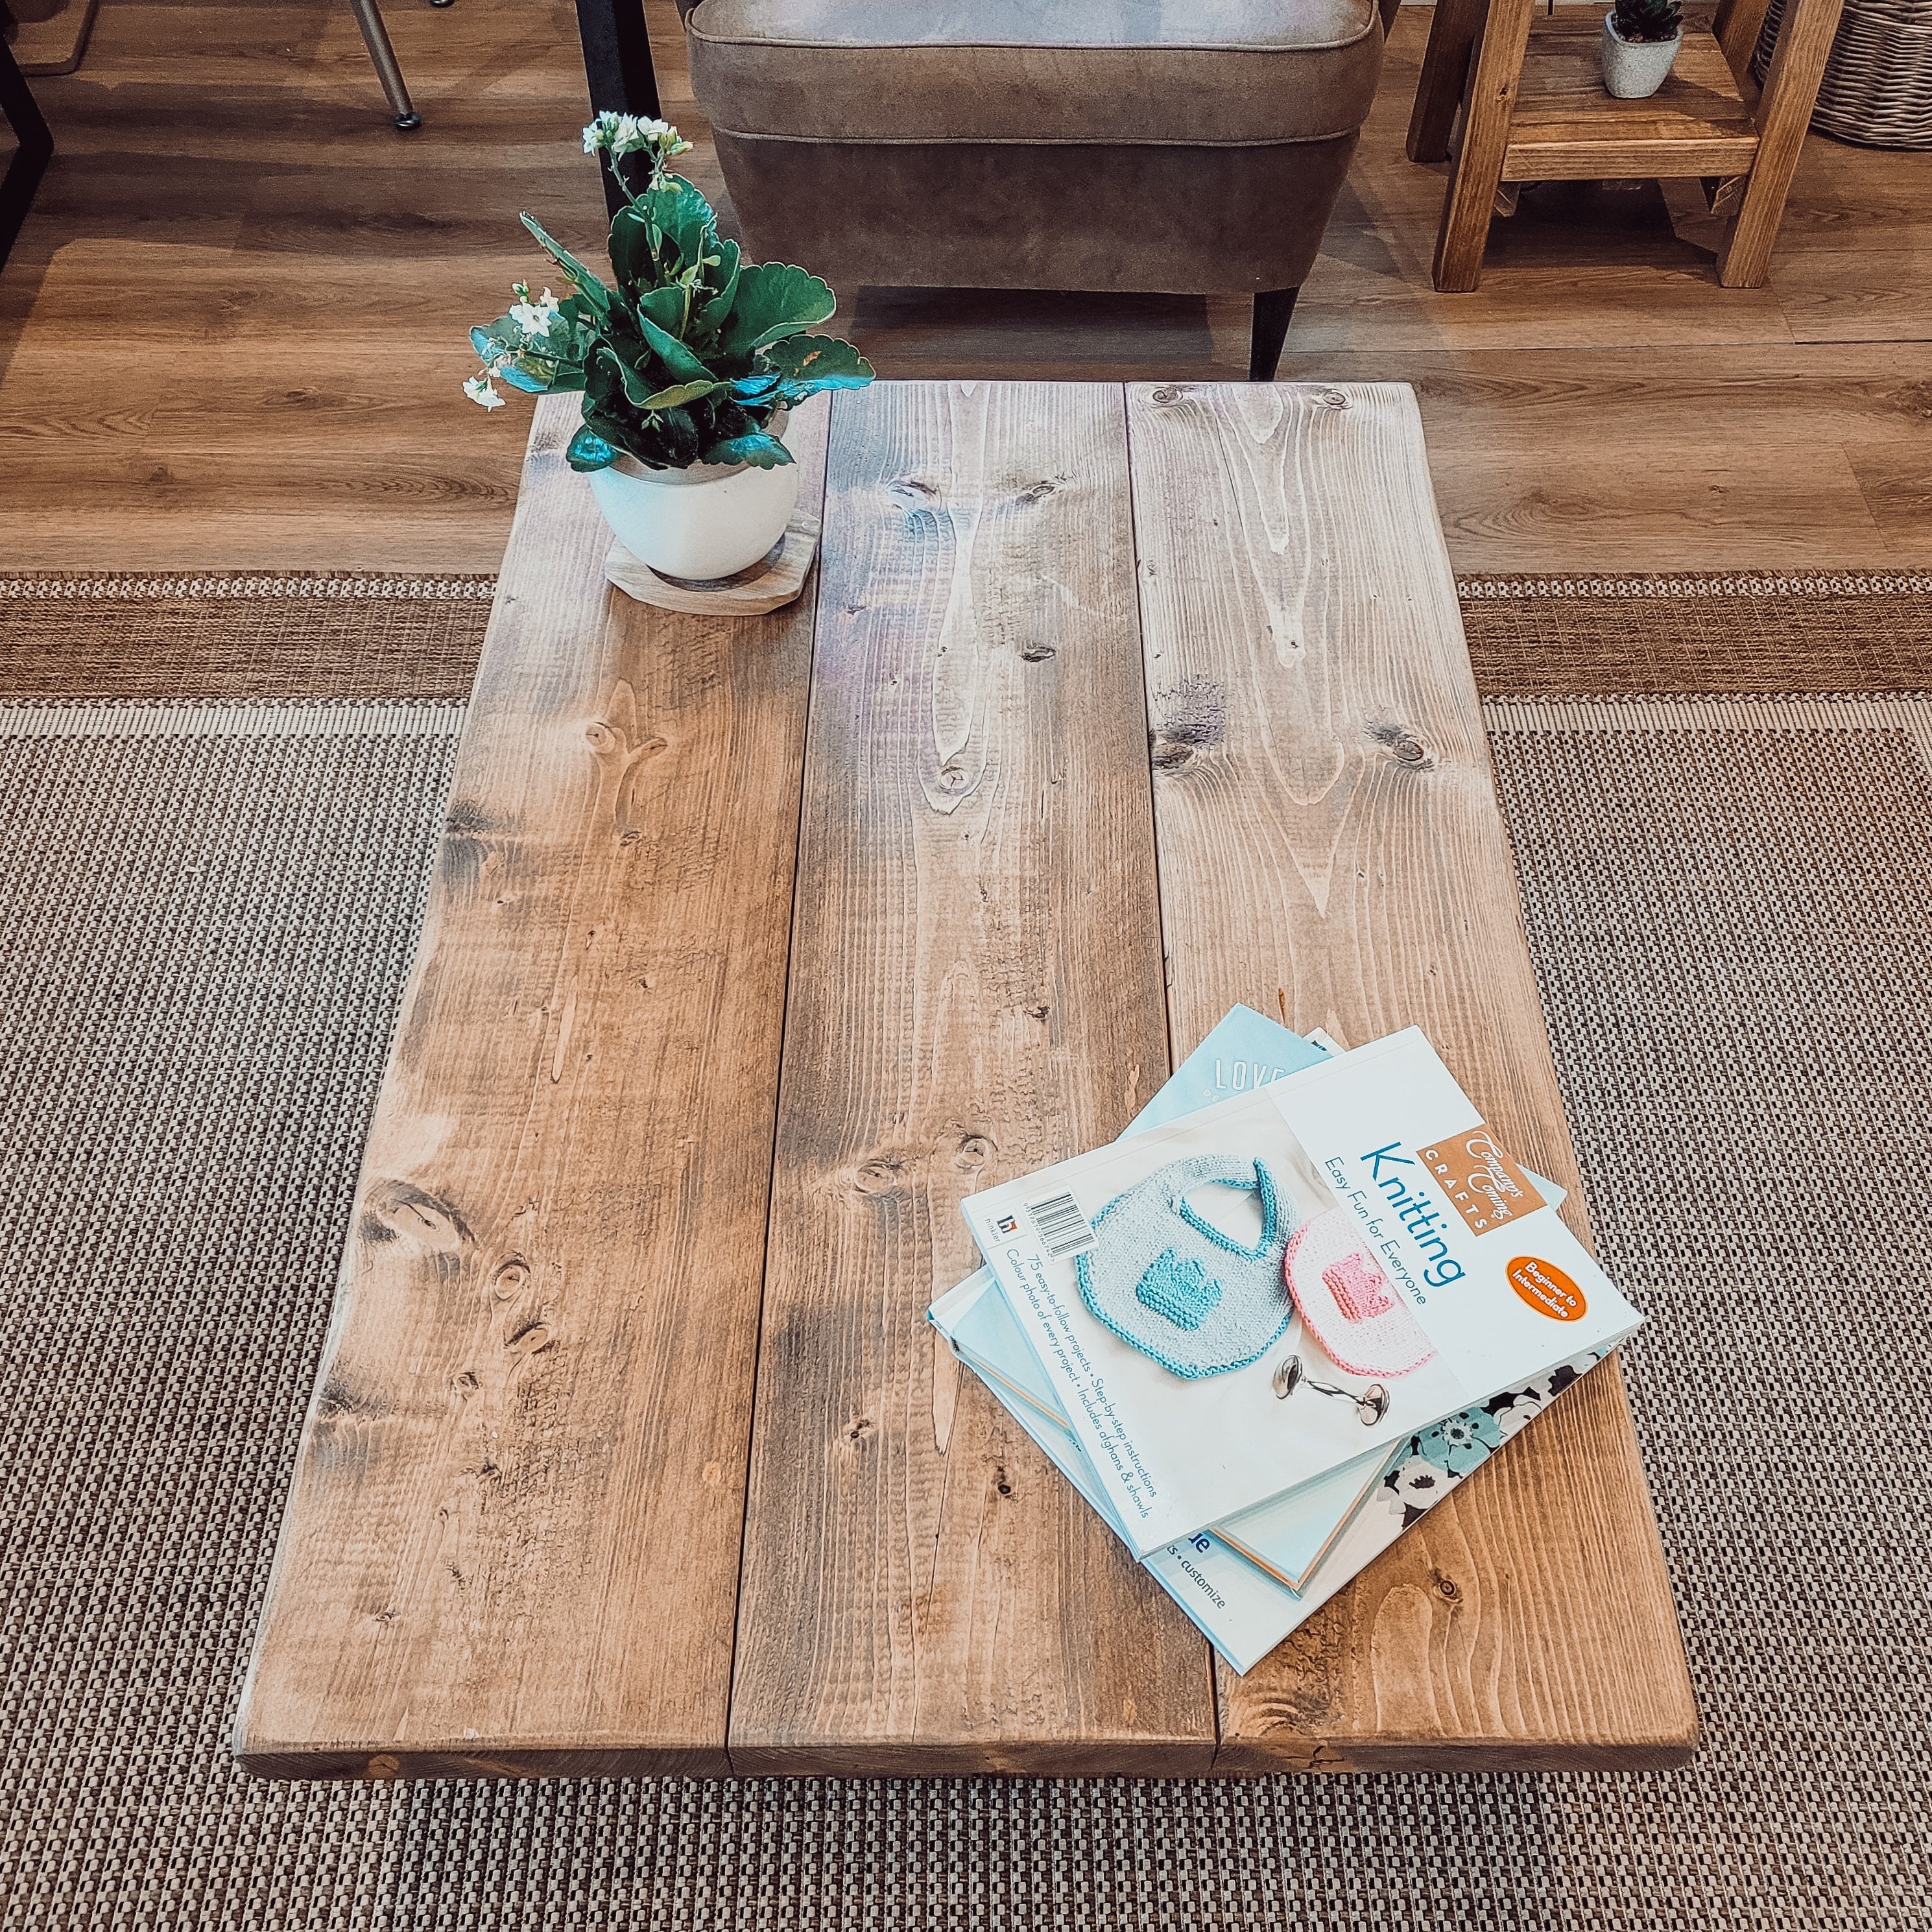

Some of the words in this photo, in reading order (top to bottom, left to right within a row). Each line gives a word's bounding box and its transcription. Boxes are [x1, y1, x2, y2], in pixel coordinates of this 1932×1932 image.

[1466, 1130, 1523, 1198] Company's
[1425, 1149, 1488, 1229] CRAFTS
[1468, 1165, 1512, 1220] Coming
[984, 1218, 1001, 1243] hinkler
[1325, 1156, 1351, 1189] Easy
[1347, 1190, 1368, 1218] Fun
[1366, 1219, 1384, 1237] for
[1380, 1239, 1426, 1304] Everyone
[1360, 1141, 1466, 1287] Knitting
[1007, 1248, 1026, 1281] Colour
[1525, 1261, 1567, 1297] Beginner
[1566, 1295, 1577, 1307] to
[1020, 1283, 1040, 1309] photo
[1512, 1269, 1568, 1317] Intermediate
[1038, 1311, 1052, 1320] of
[1043, 1322, 1060, 1347] every
[1027, 1253, 1043, 1270] 75
[1035, 1272, 1071, 1333] easy-to-follow
[1066, 1335, 1091, 1372] projects
[1091, 1377, 1127, 1440] Step-by-step
[1123, 1440, 1157, 1497] instructions
[1053, 1349, 1080, 1383] project
[1077, 1388, 1103, 1430] Includes
[1099, 1431, 1123, 1471] afghans
[1121, 1472, 1134, 1483] &
[1127, 1485, 1152, 1518] shawls
[1181, 1560, 1226, 1609] customize
